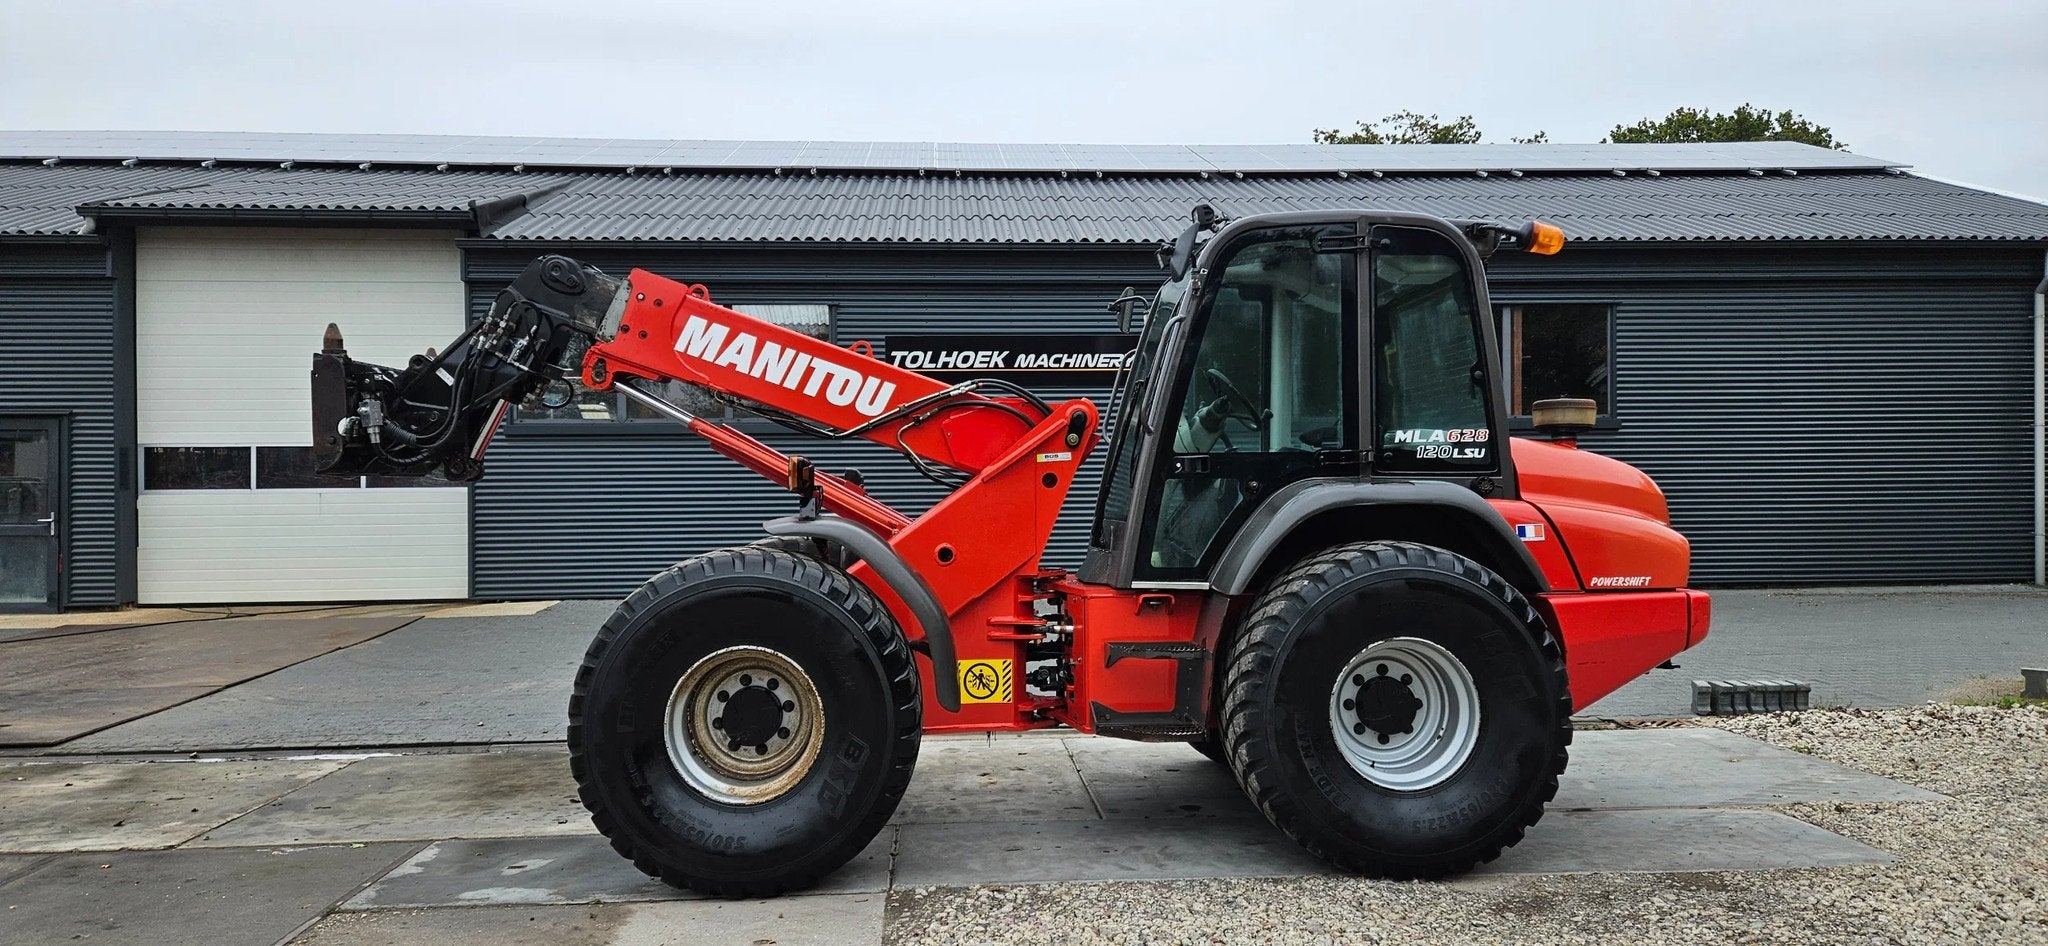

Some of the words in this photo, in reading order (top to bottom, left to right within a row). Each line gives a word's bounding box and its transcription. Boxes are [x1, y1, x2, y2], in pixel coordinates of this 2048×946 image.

[674, 315, 897, 416] MANITOU
[890, 350, 1010, 368] TOLHOEK
[1590, 576, 1651, 587] POWERSHIFT
